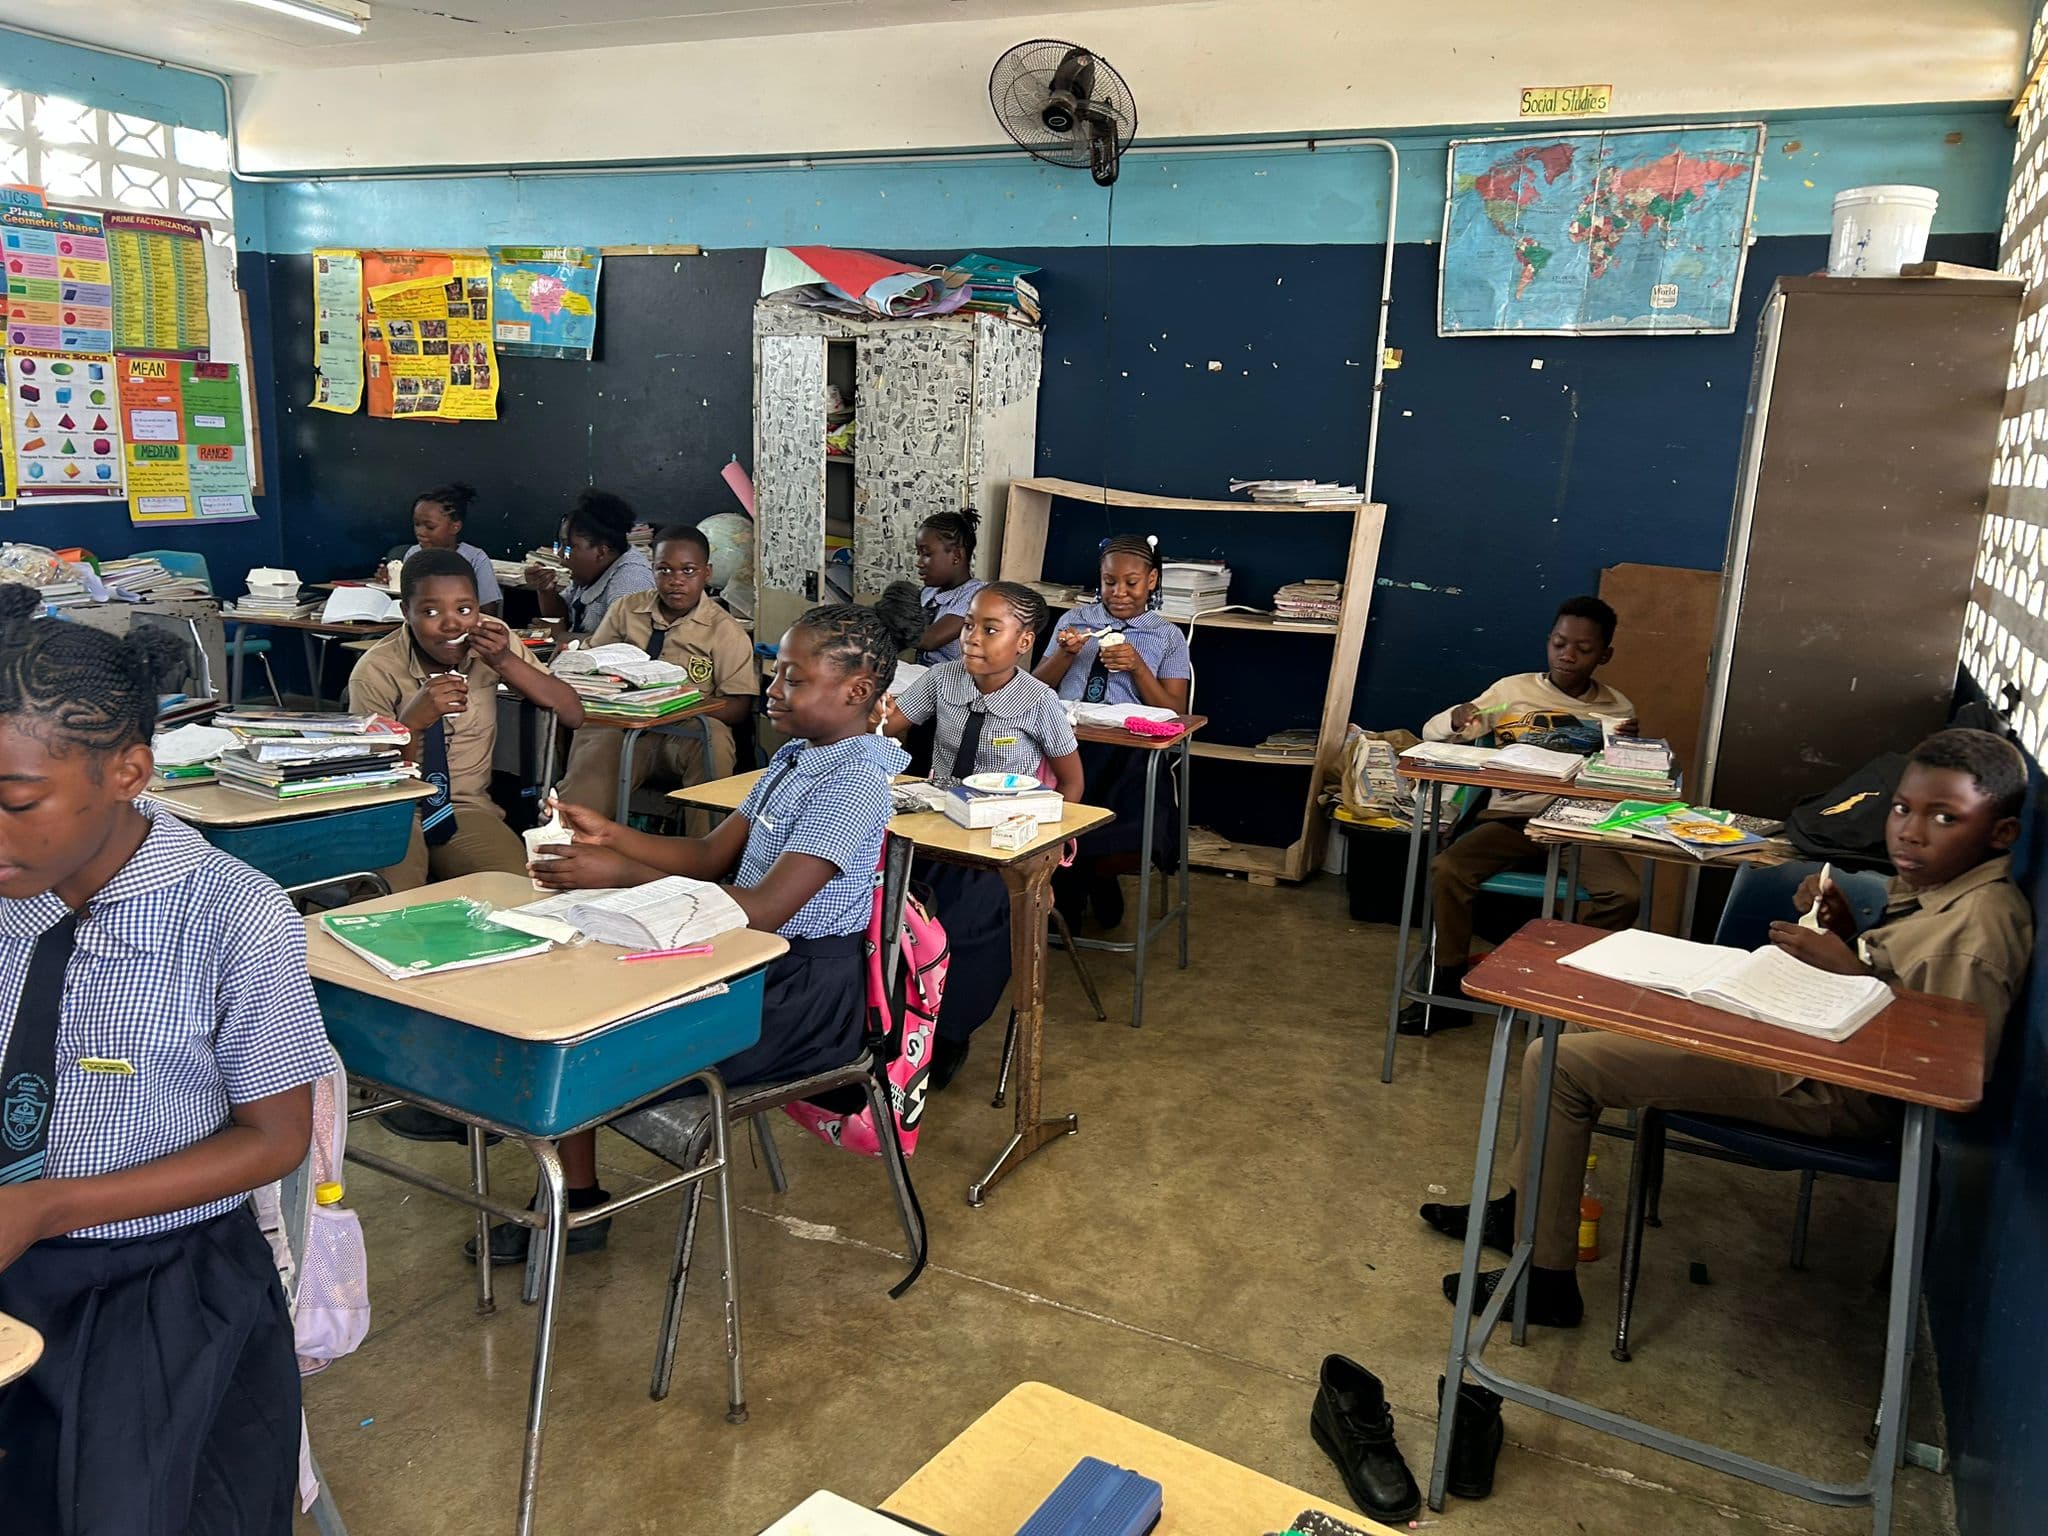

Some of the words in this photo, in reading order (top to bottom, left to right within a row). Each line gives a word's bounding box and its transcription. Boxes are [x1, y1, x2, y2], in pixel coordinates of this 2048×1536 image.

[1522, 89, 1557, 113] Social
[1561, 87, 1606, 112] Studies
[9, 206, 43, 219] Plane
[3, 213, 59, 229] Geometric
[62, 221, 100, 234] Shapes
[111, 215, 135, 224] PRIME
[136, 216, 196, 234] FACTORIZATION
[1653, 287, 1676, 296] World
[131, 361, 165, 376] MEAN
[140, 446, 179, 459] MEDIAN
[200, 447, 228, 460] RANGE
